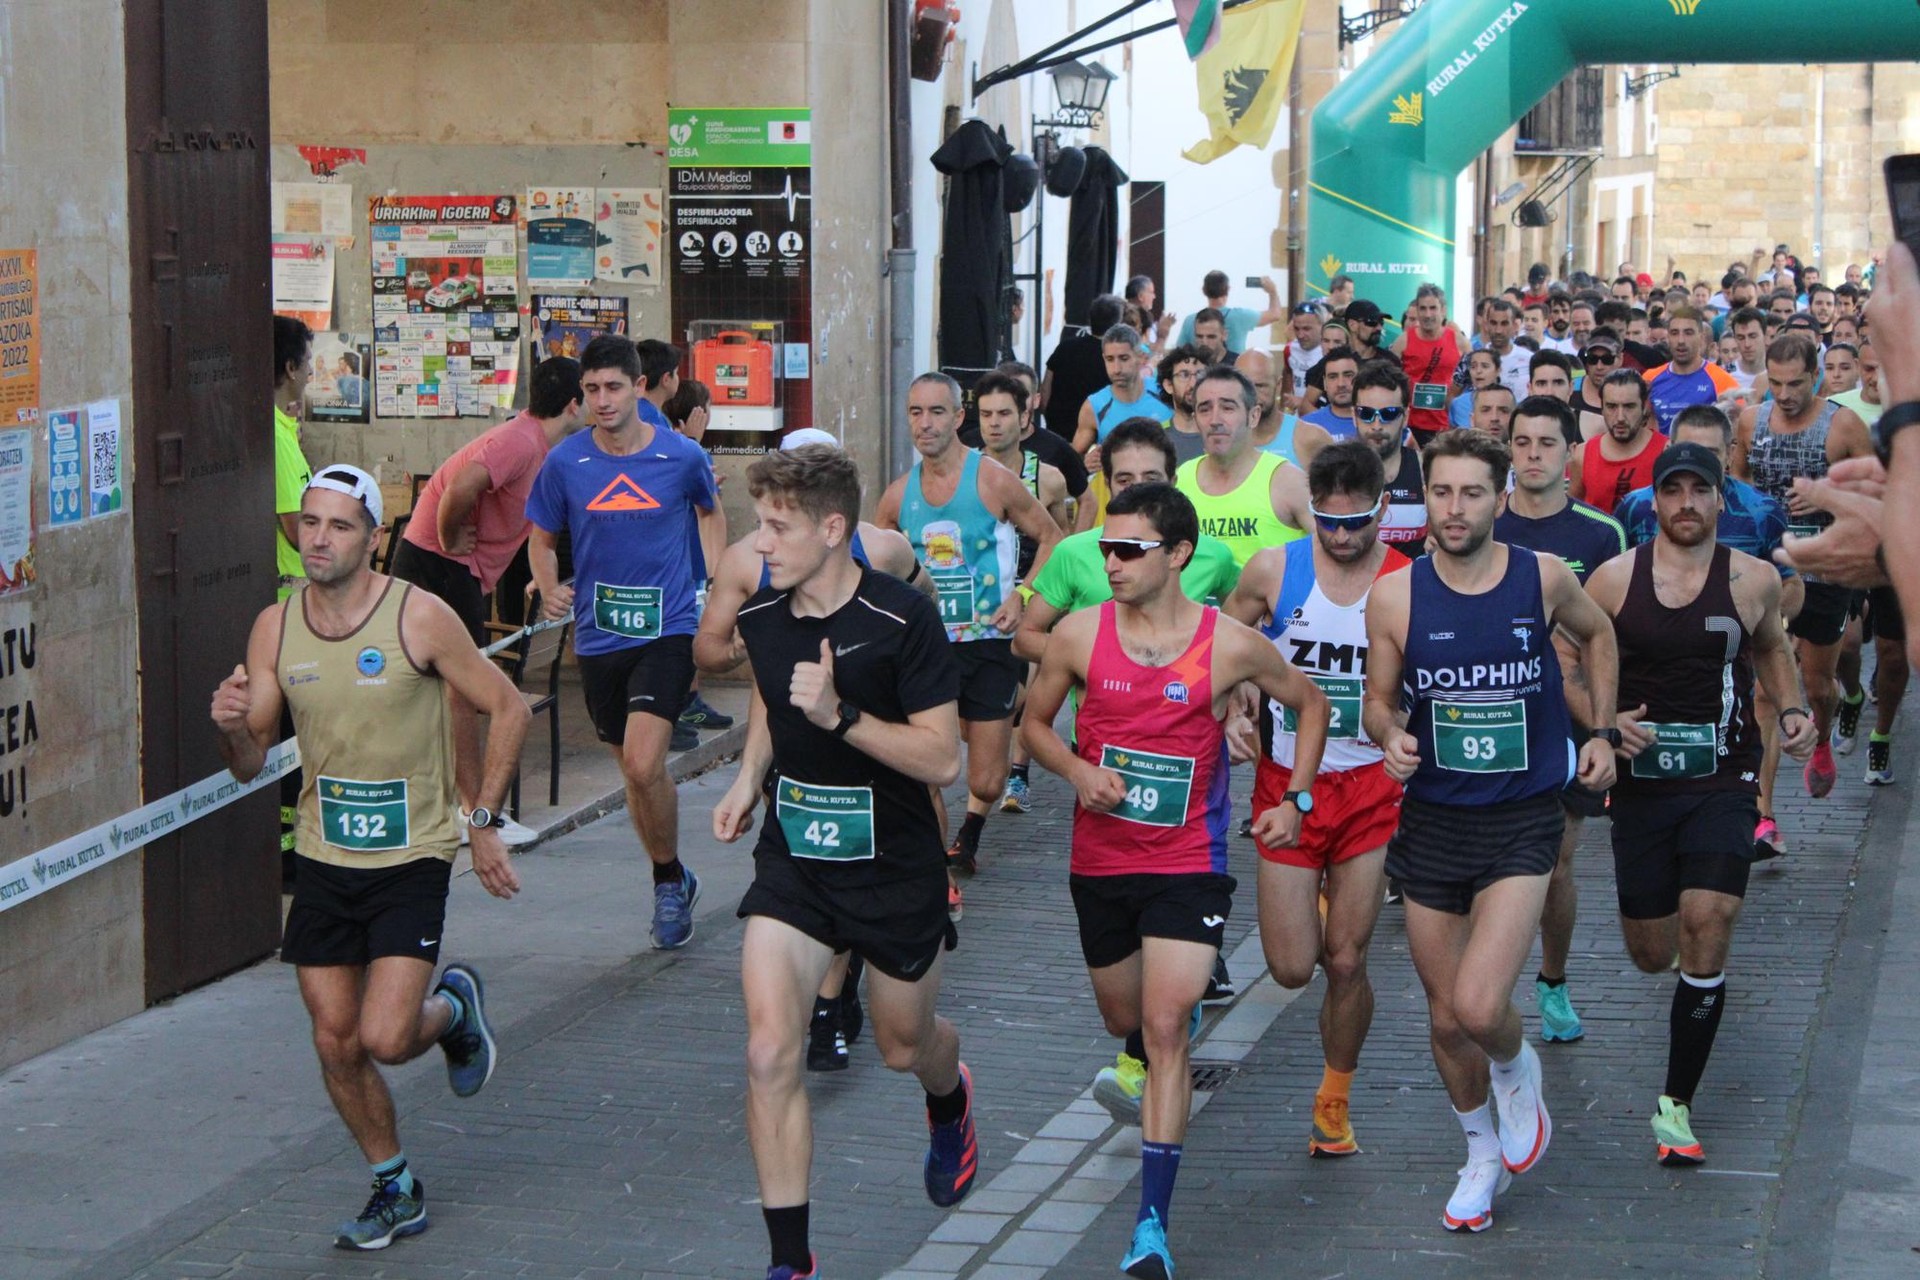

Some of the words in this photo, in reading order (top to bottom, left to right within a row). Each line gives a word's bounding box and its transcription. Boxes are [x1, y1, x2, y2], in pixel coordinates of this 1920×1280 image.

[1426, 49, 1477, 97] RURAL
[1474, 1, 1528, 48] KUTXA
[669, 147, 699, 157] DESA
[678, 170, 704, 183] IDM
[708, 170, 752, 183] Medical
[441, 205, 491, 220] IGOERA
[677, 208, 753, 217] DESFIBRILADOREA
[677, 217, 737, 226] DESFIBRILADOR
[1346, 262, 1386, 274] RURAL
[1388, 262, 1429, 275] KUTXA
[2, 345, 28, 368] 2022
[1426, 395, 1433, 405] 3
[623, 513, 654, 521] TRAIL
[609, 609, 646, 629] 116
[1284, 618, 1310, 627] VIATOR
[1417, 656, 1541, 690] DOLPHINS
[1515, 682, 1542, 696] running
[1487, 711, 1512, 719] KUTXA
[1462, 736, 1496, 760] 93
[277, 751, 296, 771] KUTXA
[1131, 760, 1155, 771] RURAL
[1155, 763, 1180, 773] KUTXA
[1658, 751, 1686, 771] 61
[192, 793, 216, 812] RURAL
[216, 781, 240, 801] KUTXA
[345, 788, 367, 797] RURAL
[368, 788, 394, 797] KUTXA
[805, 794, 829, 803] RURAL
[830, 795, 857, 804] KUTXA
[1125, 784, 1159, 811] 49
[123, 821, 150, 845] RURAL
[150, 811, 175, 833] KUTXA
[338, 812, 387, 838] 132
[804, 820, 840, 846] 42
[48, 855, 77, 878] RURAL
[78, 843, 105, 867] KUTXA
